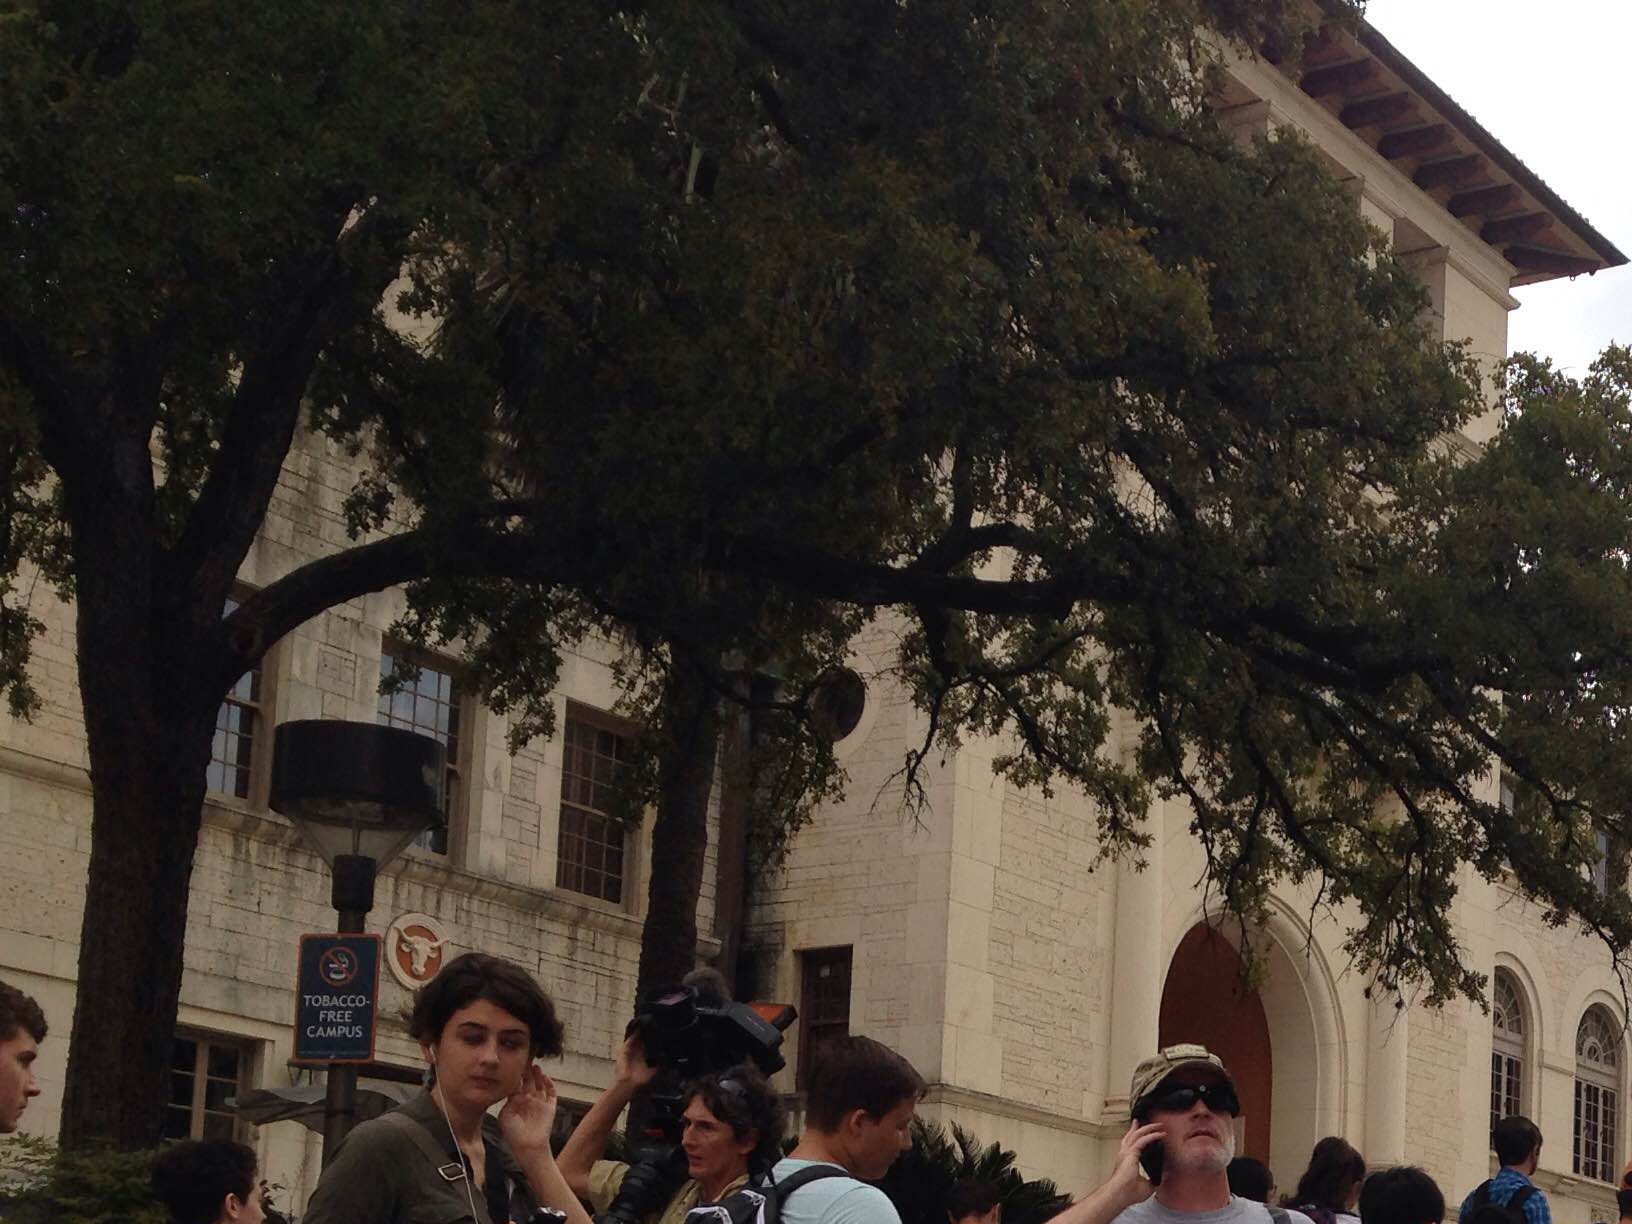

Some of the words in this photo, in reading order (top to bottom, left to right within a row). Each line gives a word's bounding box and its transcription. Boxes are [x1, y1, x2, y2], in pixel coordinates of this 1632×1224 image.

[304, 995, 370, 1007] TOBACCO-
[319, 1010, 352, 1022] FREE
[307, 1025, 363, 1038] CAMPUS
